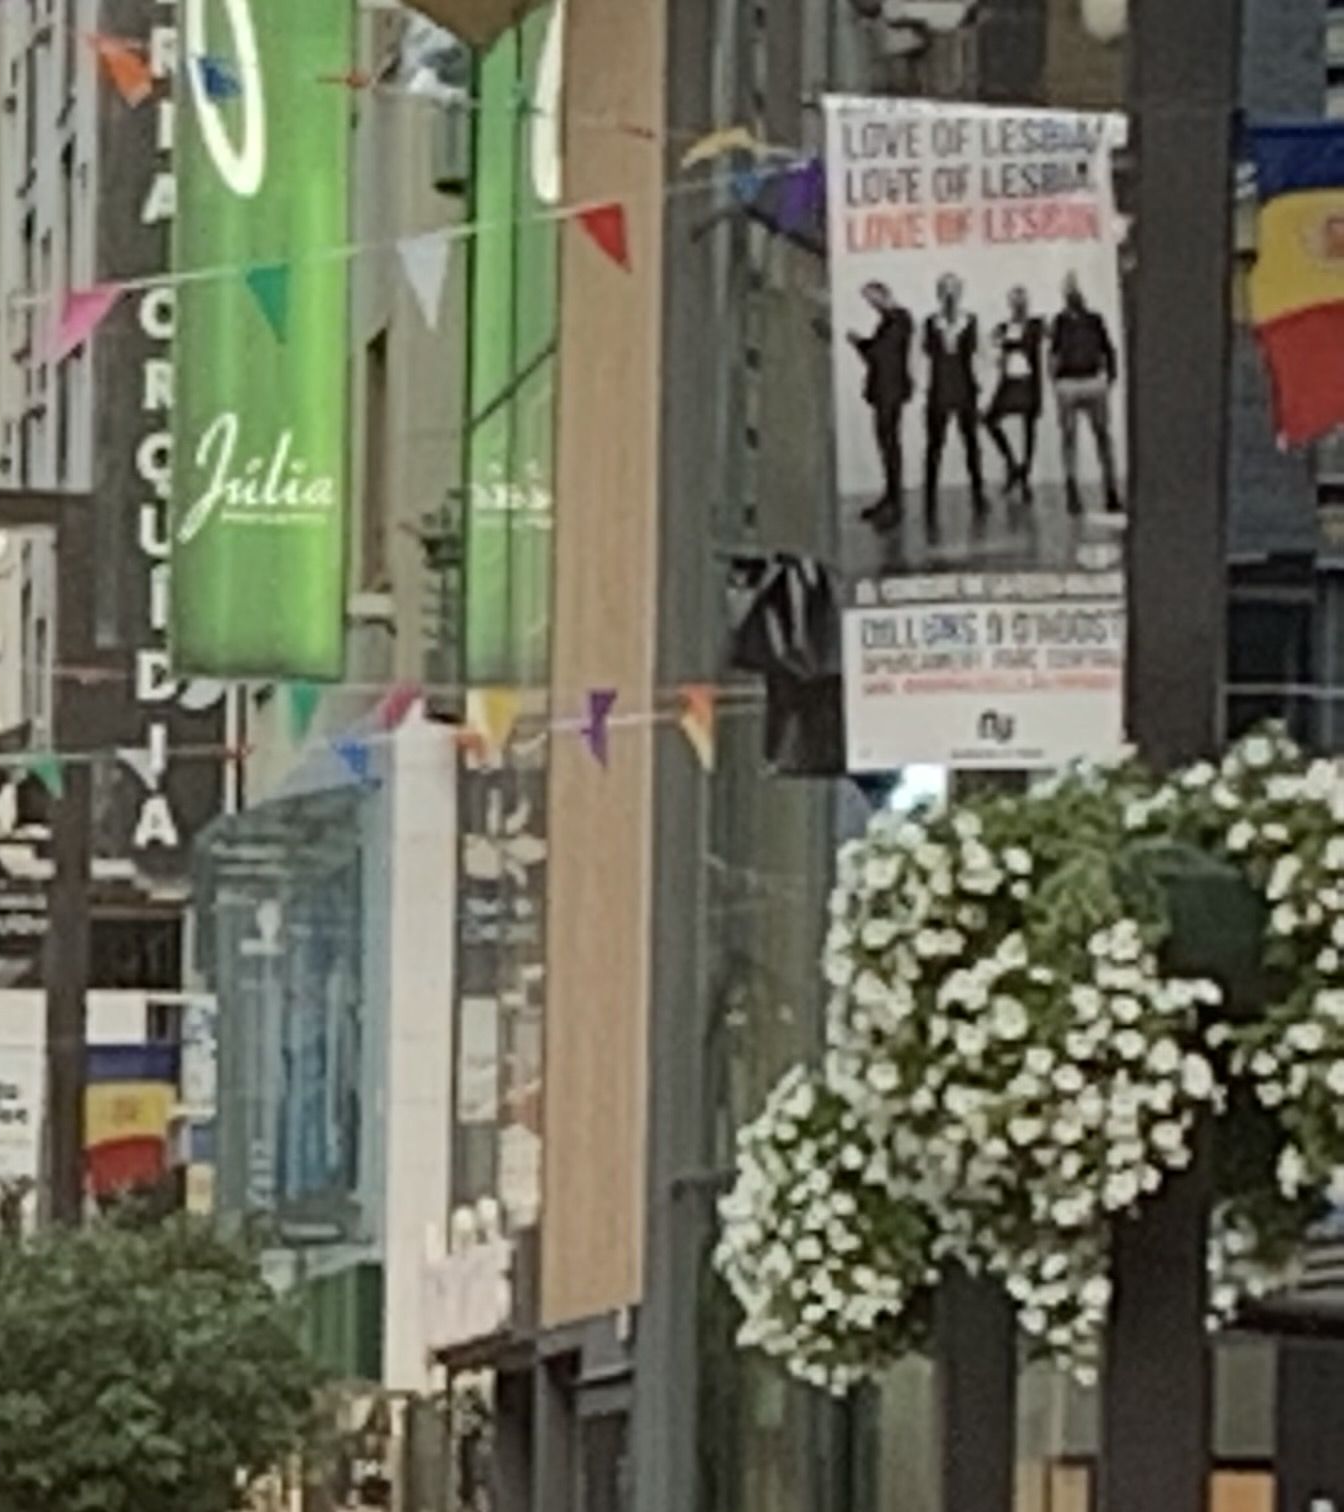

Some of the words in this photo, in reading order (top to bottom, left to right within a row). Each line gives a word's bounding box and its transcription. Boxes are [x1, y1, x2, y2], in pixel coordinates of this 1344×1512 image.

[842, 120, 920, 160] LOVE
[931, 116, 968, 158] OF
[845, 166, 921, 207] LOVE
[931, 163, 972, 204] OF
[845, 209, 925, 253] LOVE
[176, 412, 333, 544] Júlia
